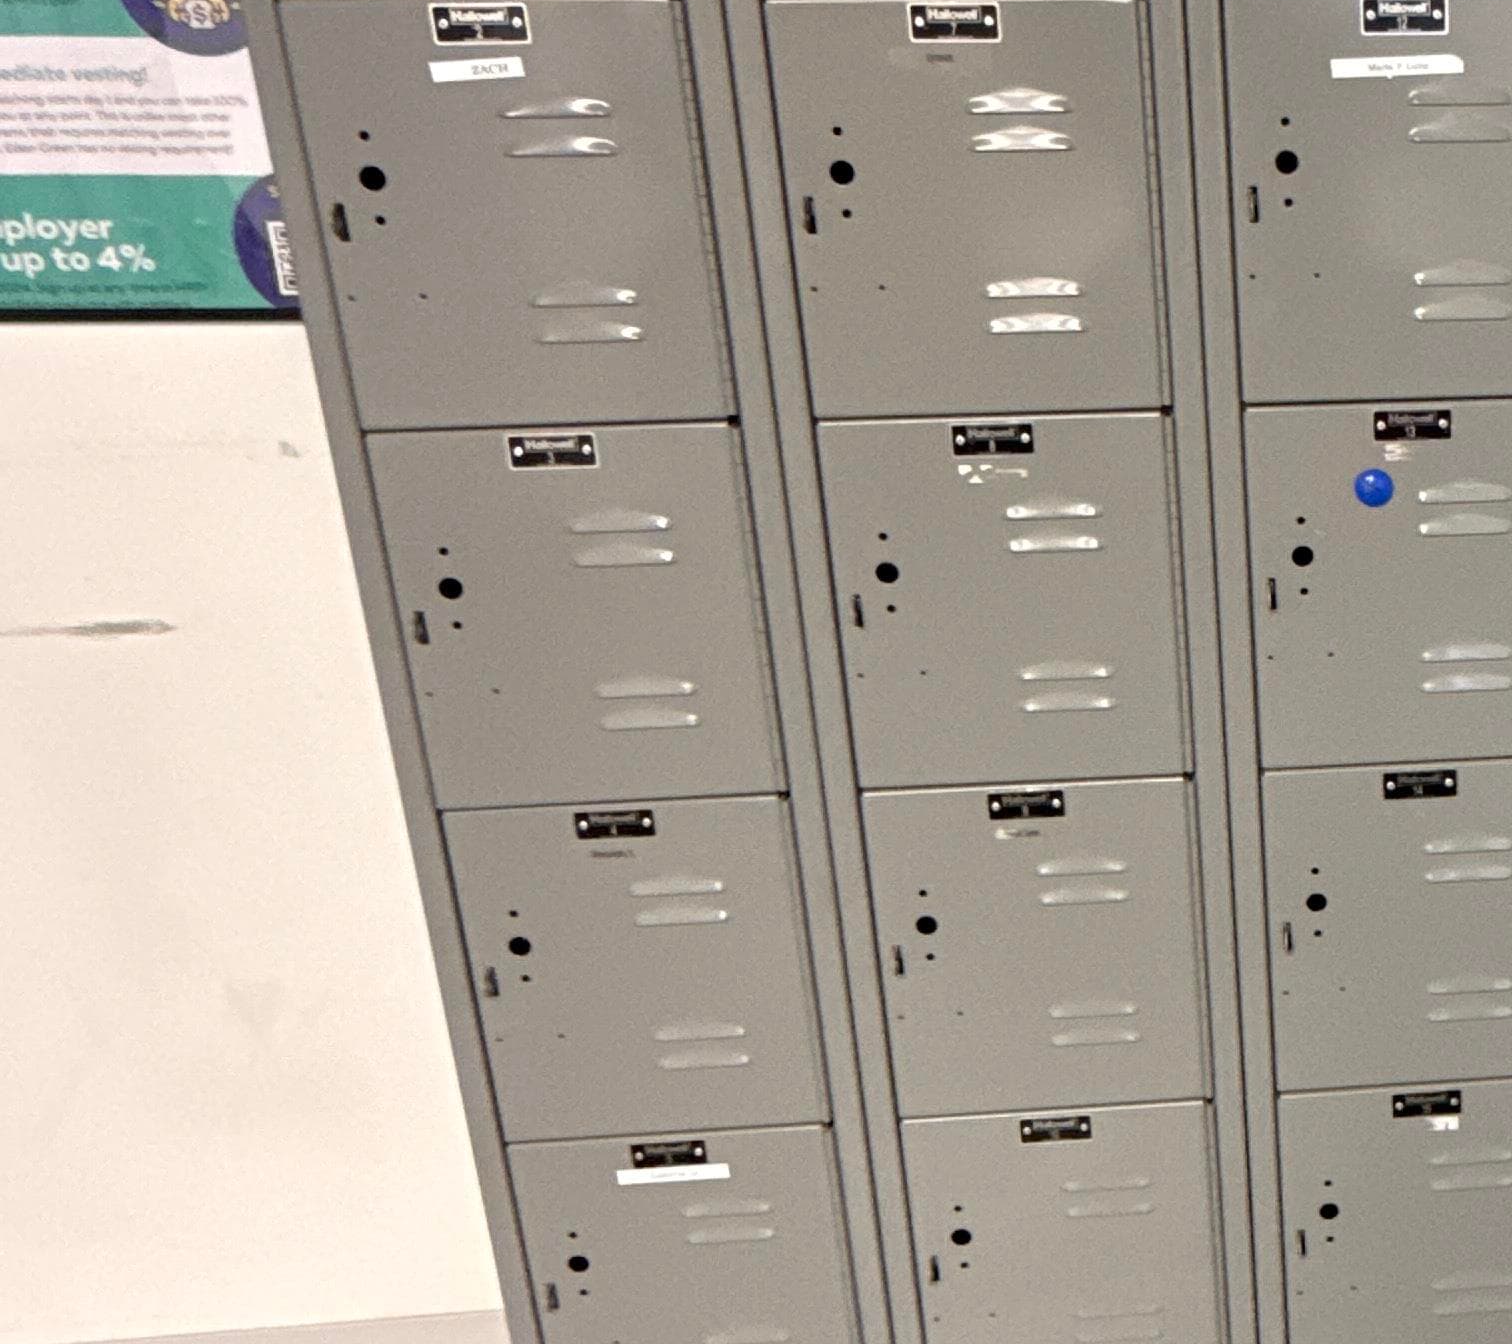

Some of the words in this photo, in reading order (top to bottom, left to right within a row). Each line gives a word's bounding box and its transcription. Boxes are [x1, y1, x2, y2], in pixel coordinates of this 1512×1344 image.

[0, 211, 114, 247] ployer
[3, 252, 46, 279] up
[52, 247, 91, 272] to
[97, 243, 157, 273] 4%
